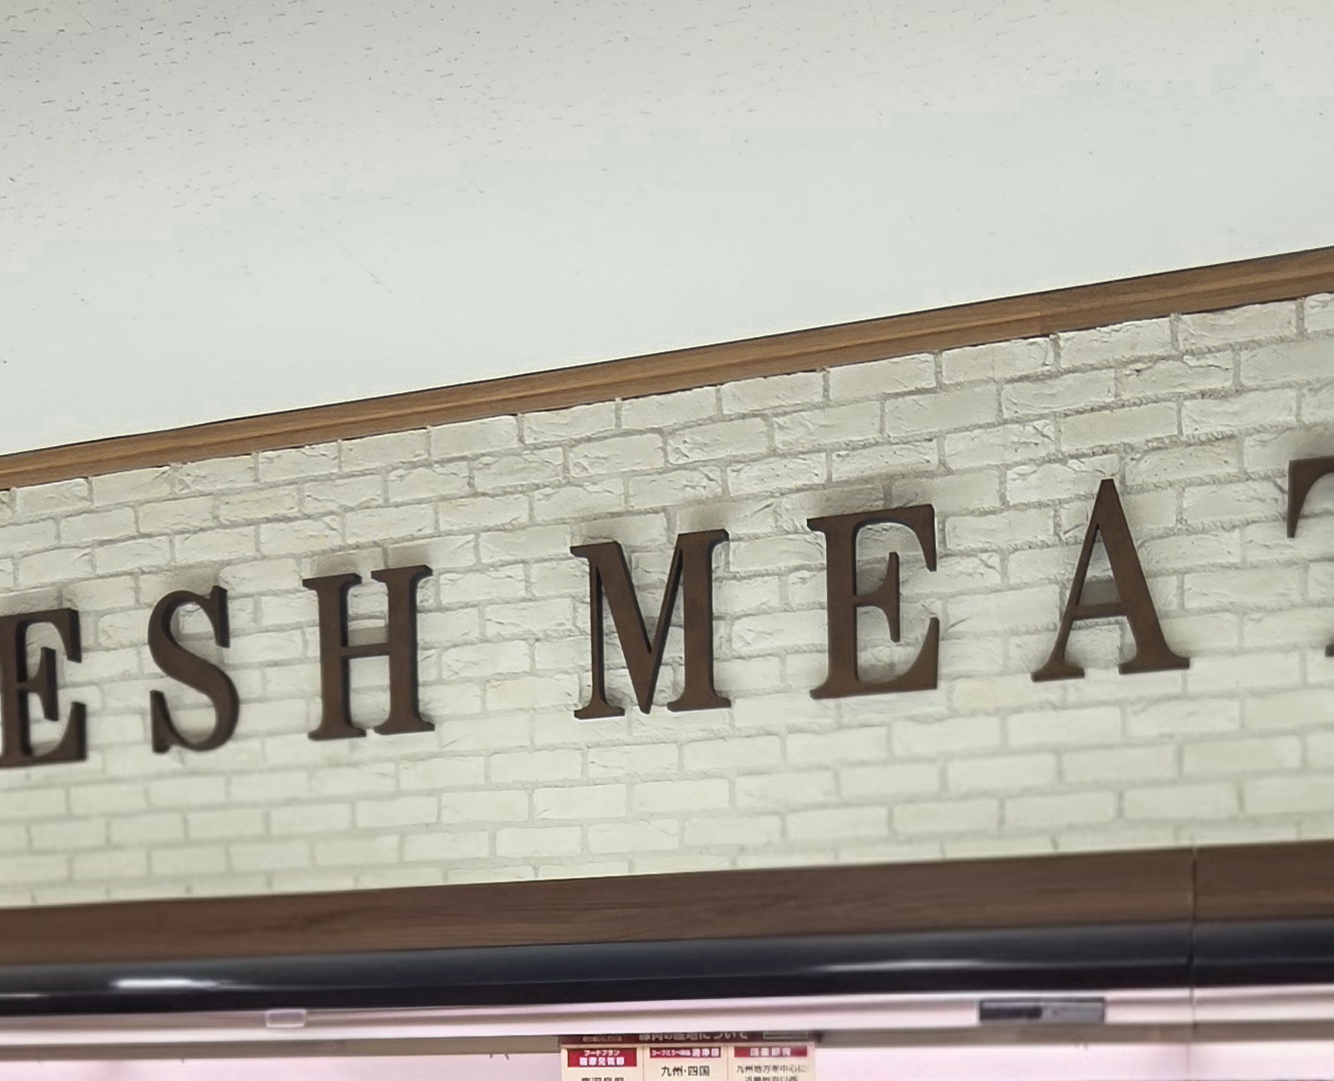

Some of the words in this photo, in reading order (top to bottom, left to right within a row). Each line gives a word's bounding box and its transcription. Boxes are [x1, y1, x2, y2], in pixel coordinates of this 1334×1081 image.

[661, 1065, 710, 1077] 九州・四国
[736, 1064, 806, 1074] 九州地方を中心に
